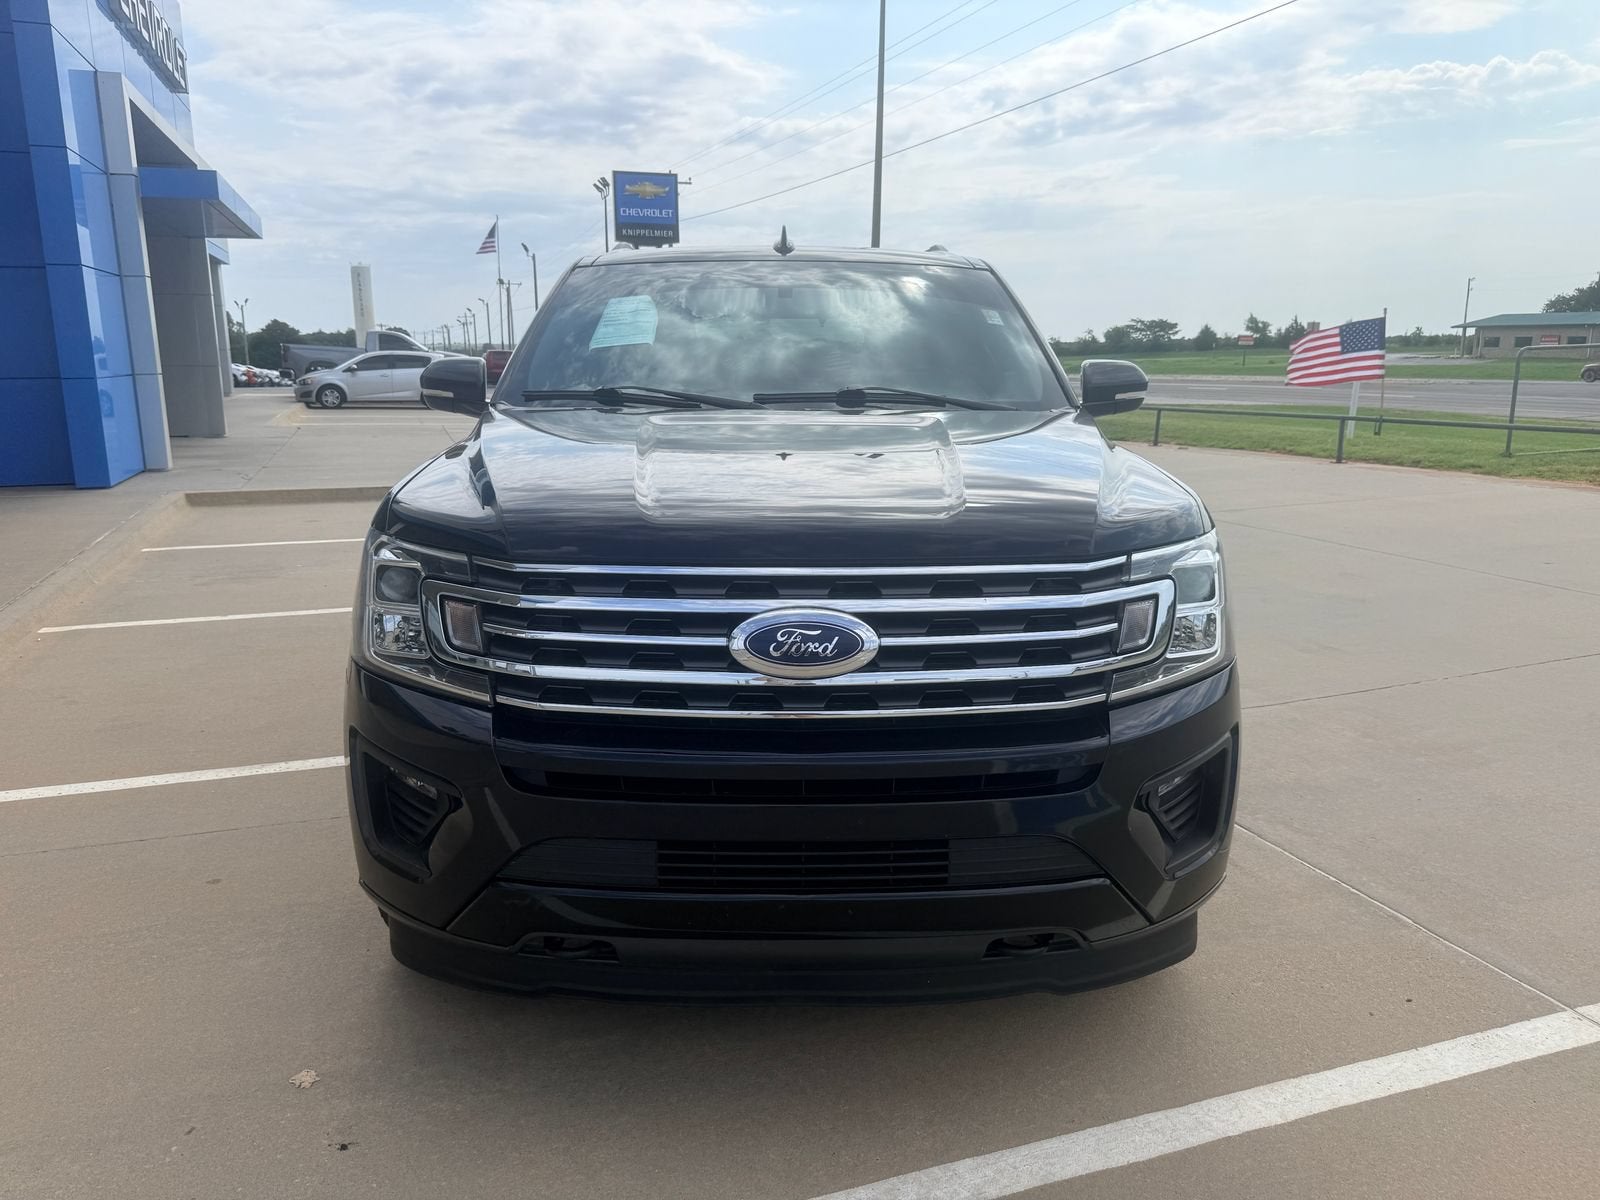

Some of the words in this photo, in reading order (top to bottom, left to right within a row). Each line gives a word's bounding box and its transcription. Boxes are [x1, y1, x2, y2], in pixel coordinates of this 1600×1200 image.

[620, 207, 673, 218] CHEVROLET
[622, 228, 673, 238] KNIPPELMIER
[769, 628, 840, 657] Ford
